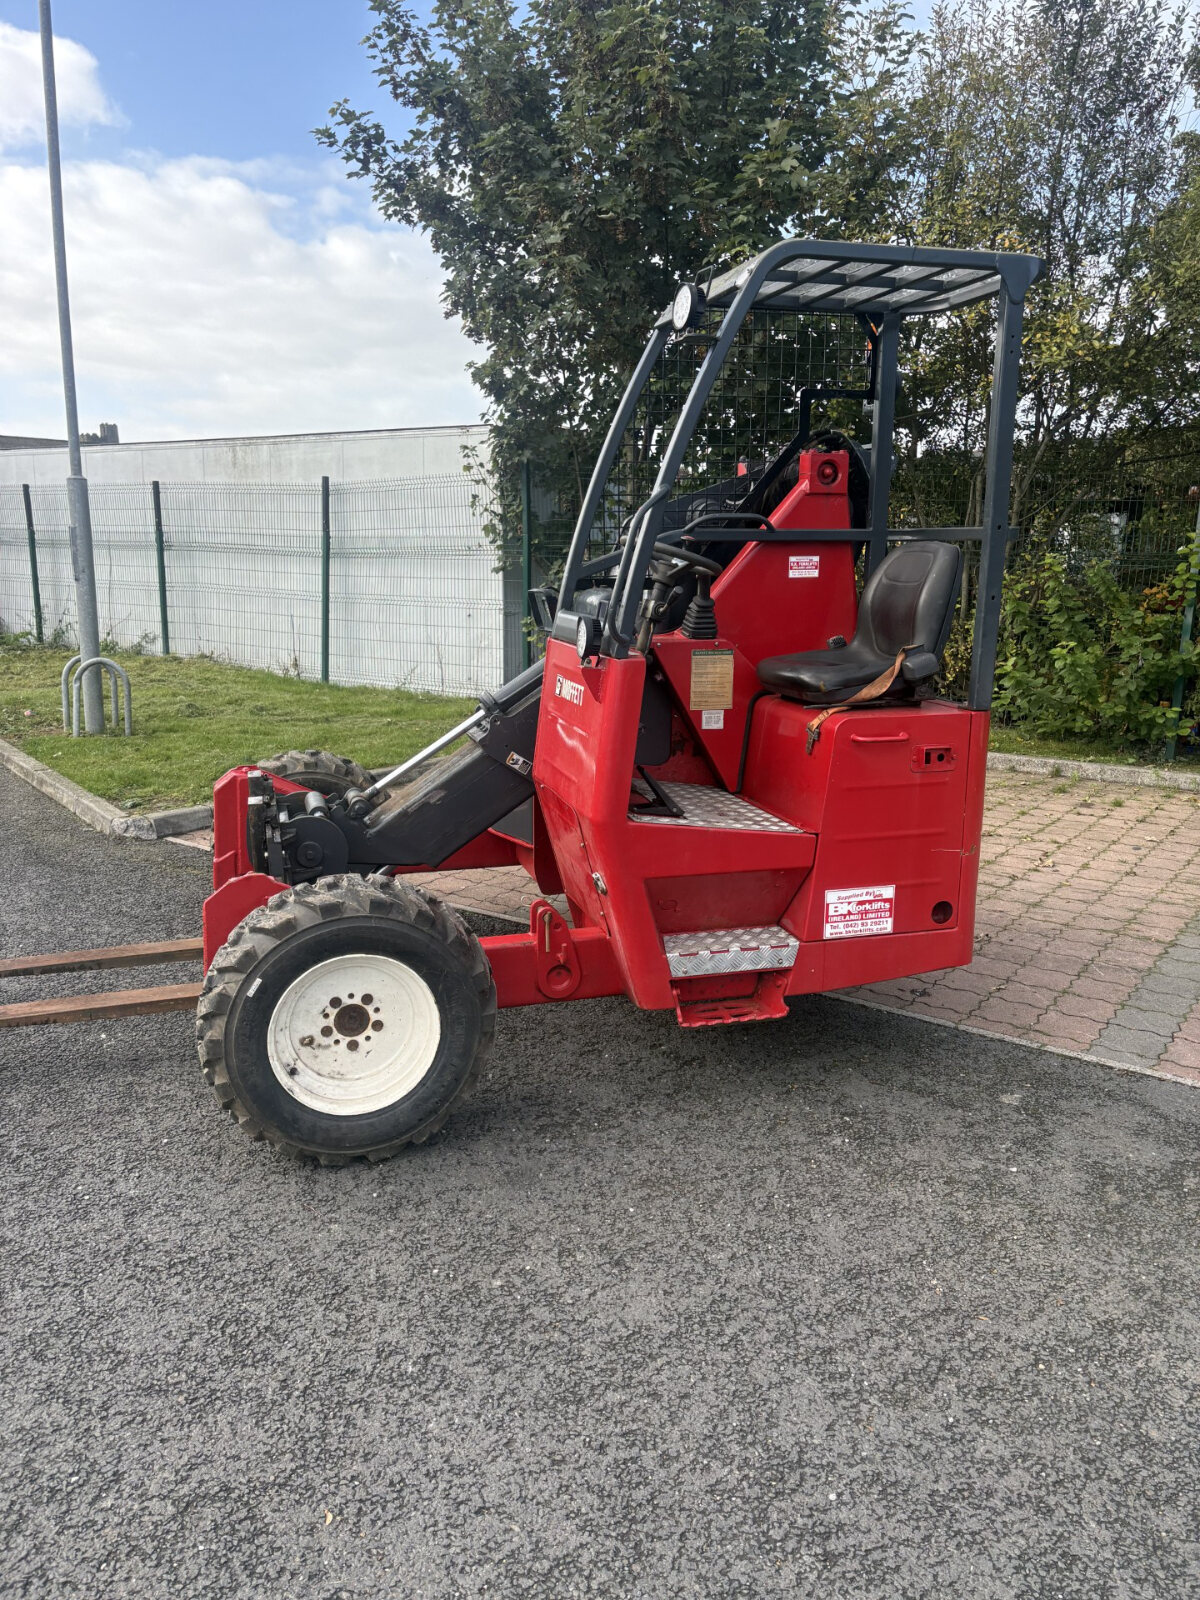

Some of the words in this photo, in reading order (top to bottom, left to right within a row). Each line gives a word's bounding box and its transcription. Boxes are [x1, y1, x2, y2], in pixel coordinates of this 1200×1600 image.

[562, 678, 584, 706] MOFFETT
[836, 892, 864, 901] Supplied
[829, 913, 861, 922] (IRELAND)
[863, 911, 890, 919] LIMITED
[843, 922, 859, 930] (042)
